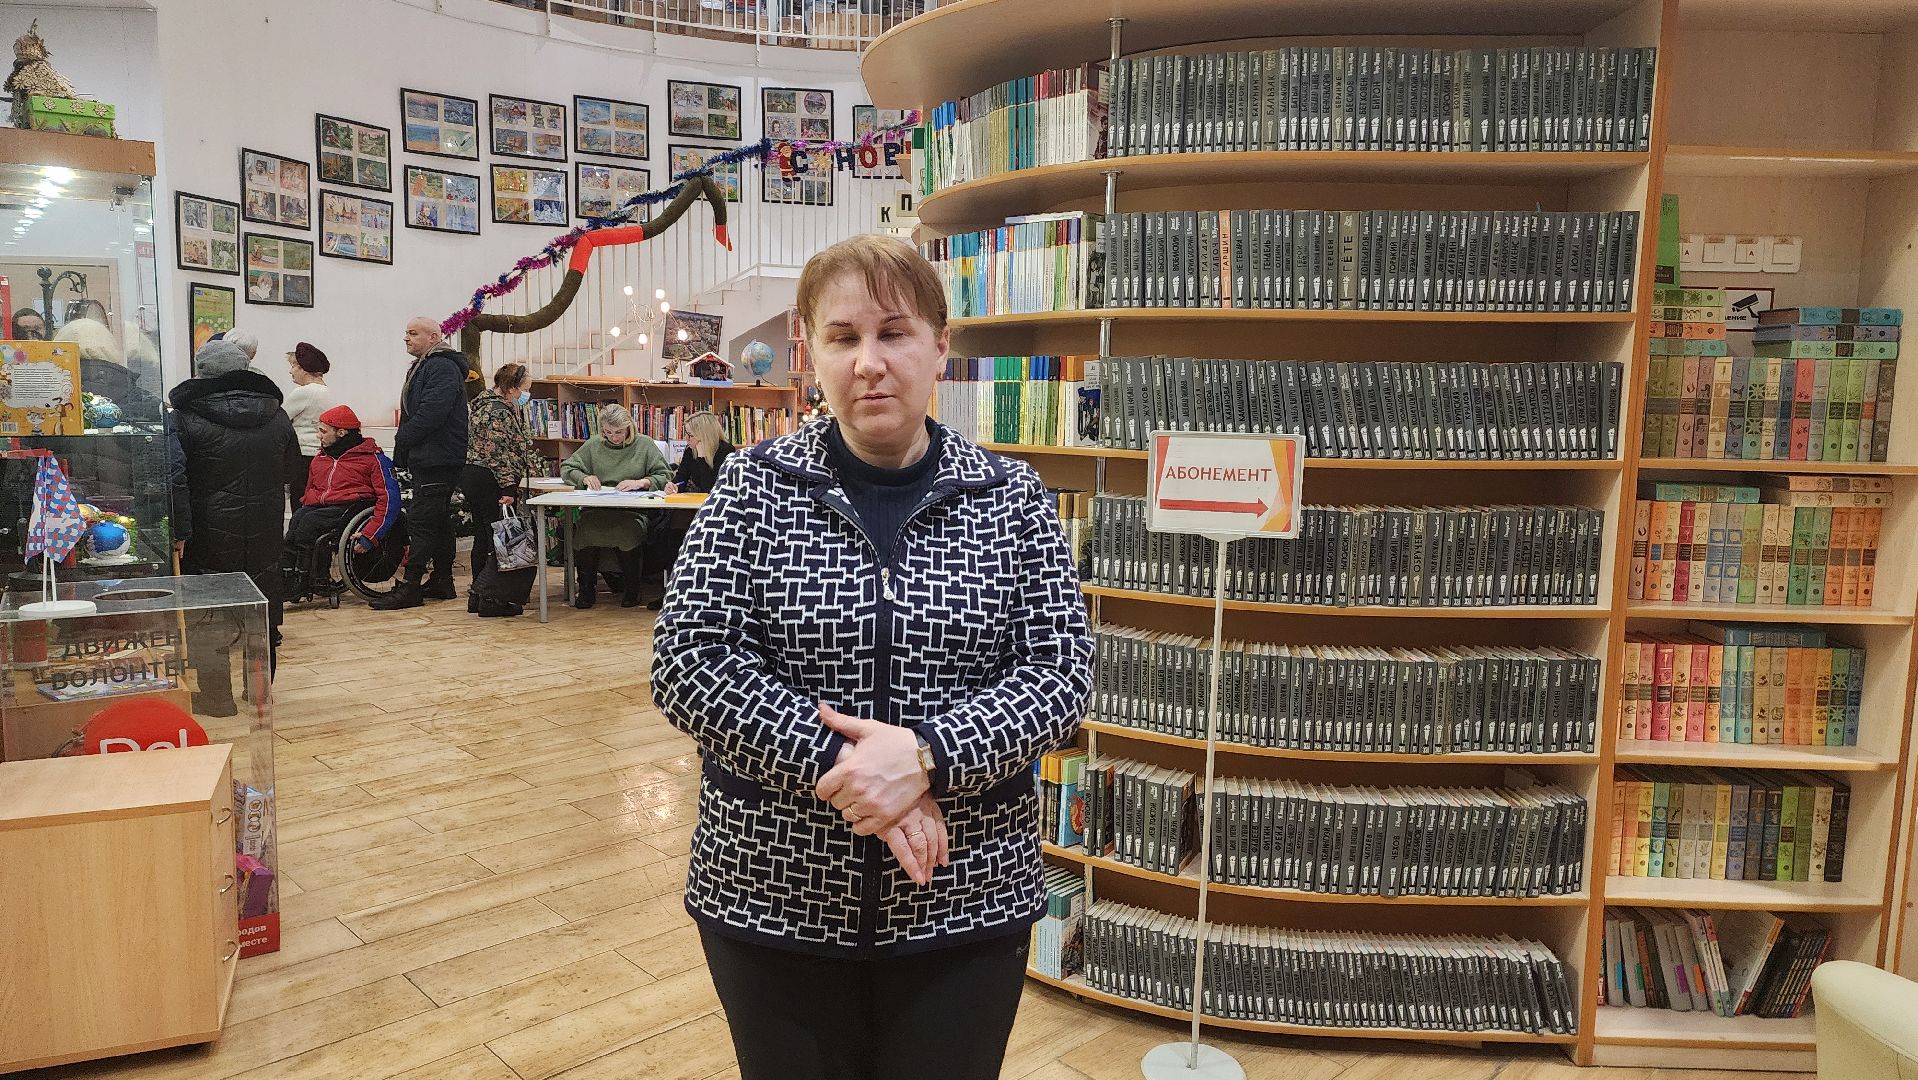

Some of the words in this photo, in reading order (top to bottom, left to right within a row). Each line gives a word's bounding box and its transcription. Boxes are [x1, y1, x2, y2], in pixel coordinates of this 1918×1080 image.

[791, 150, 809, 173] С
[881, 206, 891, 223] К
[1165, 466, 1272, 482] АБОНЕМЕНТ
